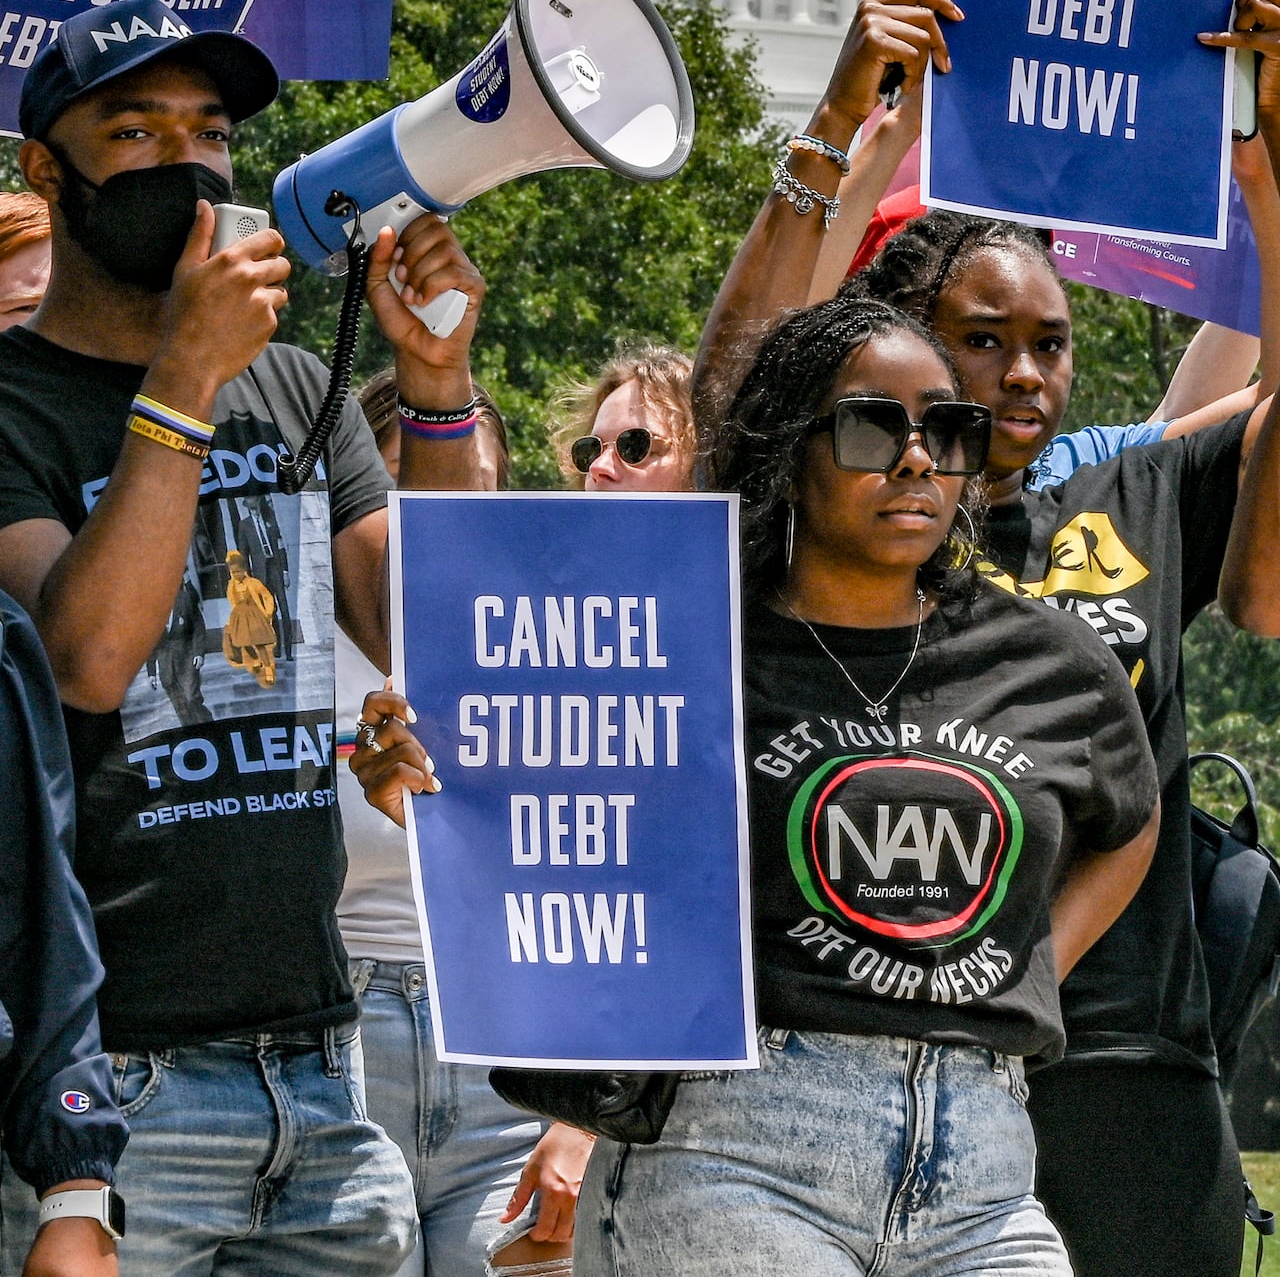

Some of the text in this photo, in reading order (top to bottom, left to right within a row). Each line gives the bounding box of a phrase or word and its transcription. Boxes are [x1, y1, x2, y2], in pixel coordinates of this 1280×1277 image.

[470, 55, 497, 93] STUDENT
[470, 86, 489, 112] DEBT
[487, 66, 505, 95] NOW!
[1008, 56, 1139, 140] NOW!
[1162, 250, 1192, 267] Courts.
[132, 419, 152, 435] Iota
[154, 428, 173, 443] Phi
[174, 437, 202, 455] Theta
[474, 595, 668, 669] CANCEL
[457, 695, 685, 767] STUDENT
[754, 716, 1035, 780] GET YOUR KNEE
[127, 737, 219, 790] TO
[138, 797, 242, 829] DEFEND
[245, 790, 310, 813] BLACK
[510, 795, 635, 866] DEBT
[826, 804, 992, 886] NAN
[856, 883, 950, 900] Founded 1991
[505, 892, 648, 964] NOW!
[786, 916, 1014, 1005] OFF OUR NECKS
